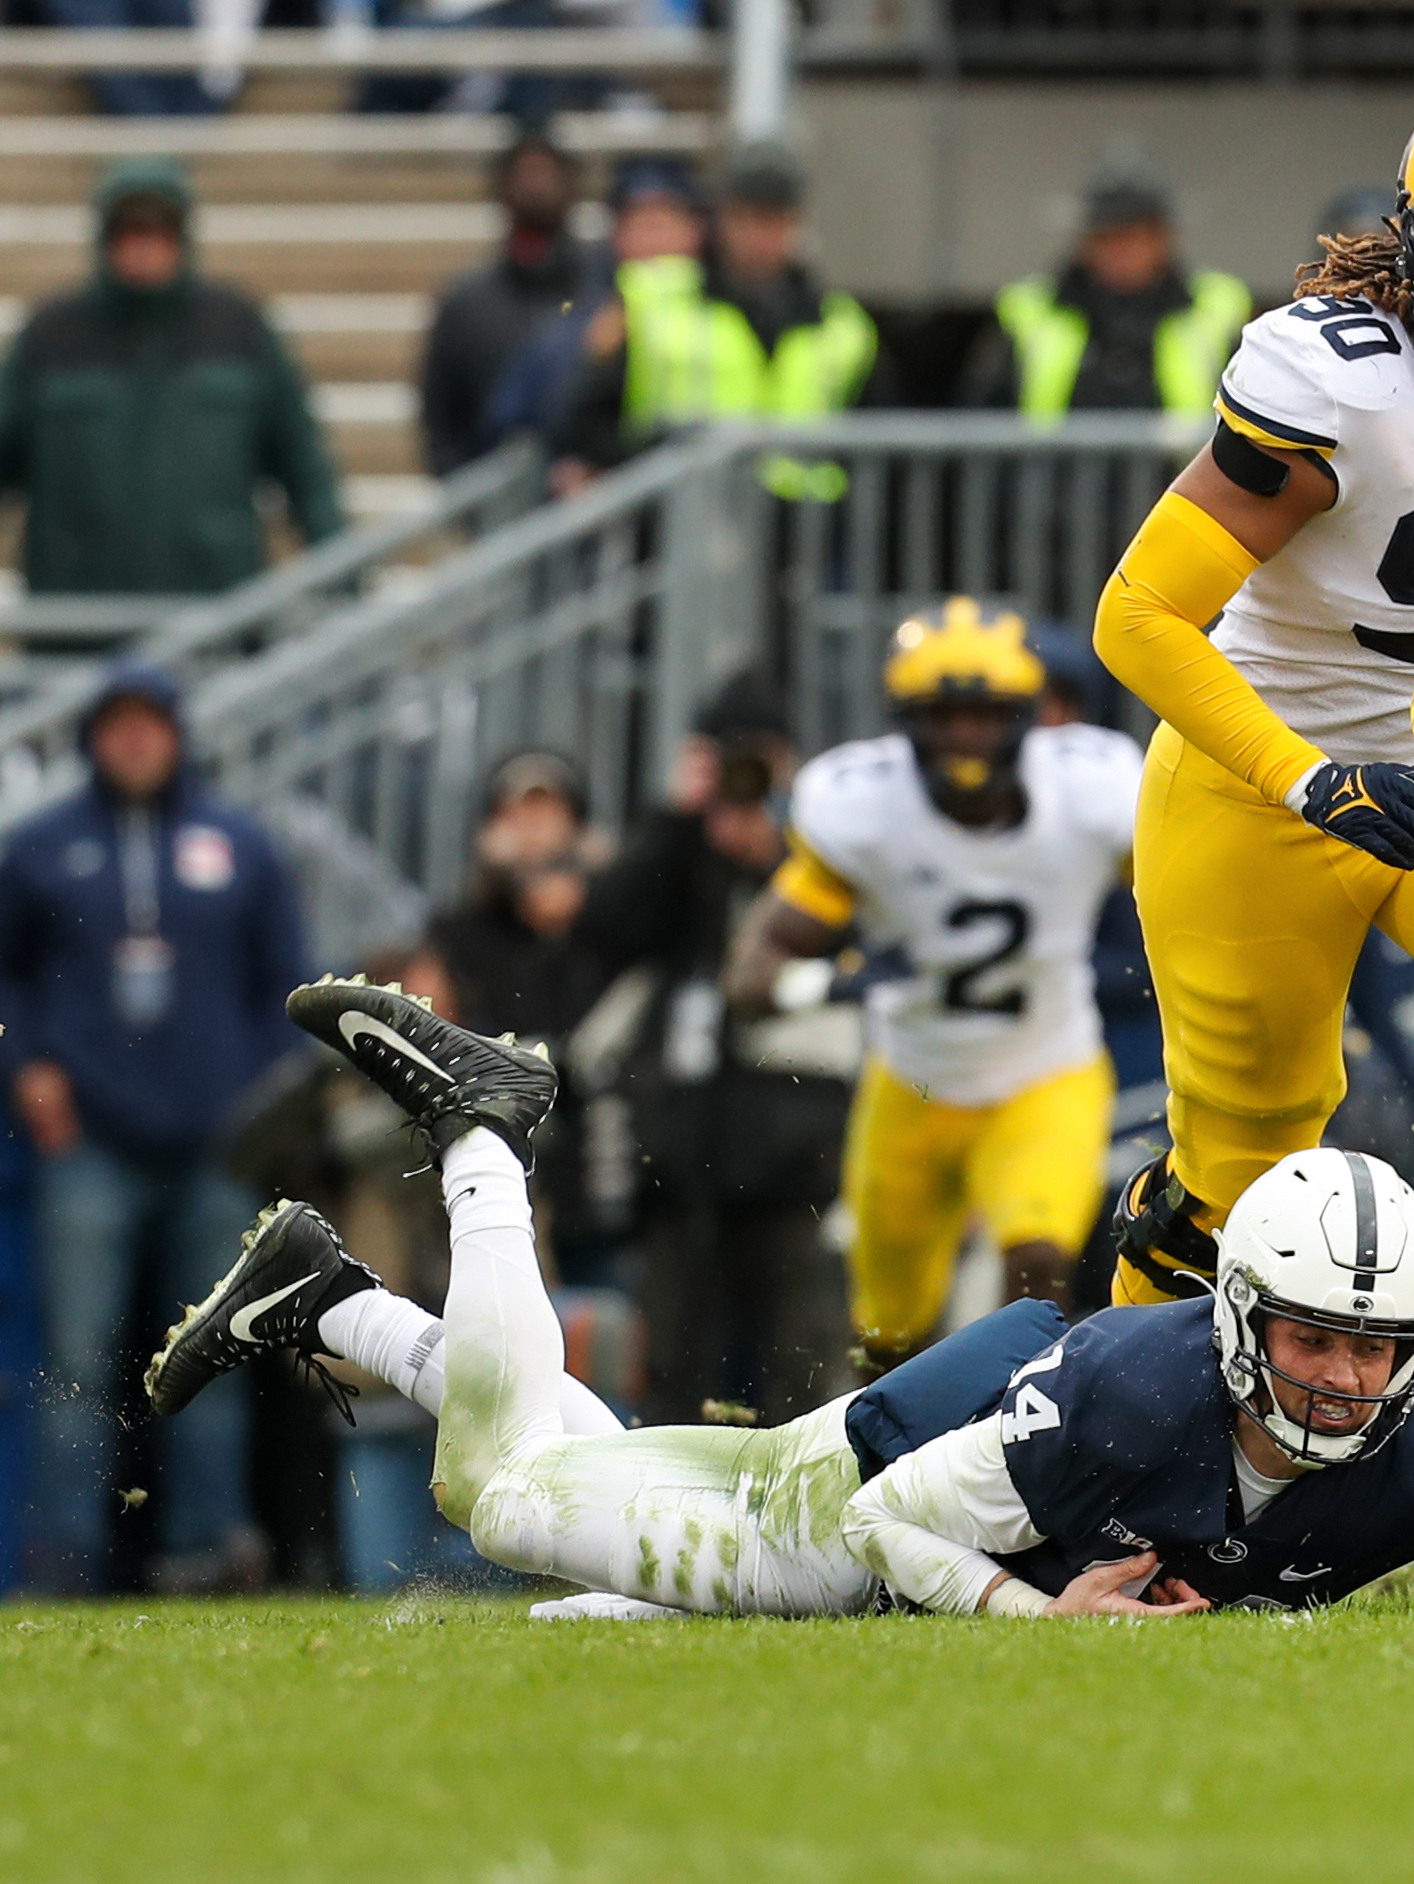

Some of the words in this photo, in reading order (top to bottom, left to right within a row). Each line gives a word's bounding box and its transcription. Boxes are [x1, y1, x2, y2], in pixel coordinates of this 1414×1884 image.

[1288, 294, 1402, 362] 90
[943, 896, 1030, 1016] 2
[1001, 1343, 1064, 1446] 14
